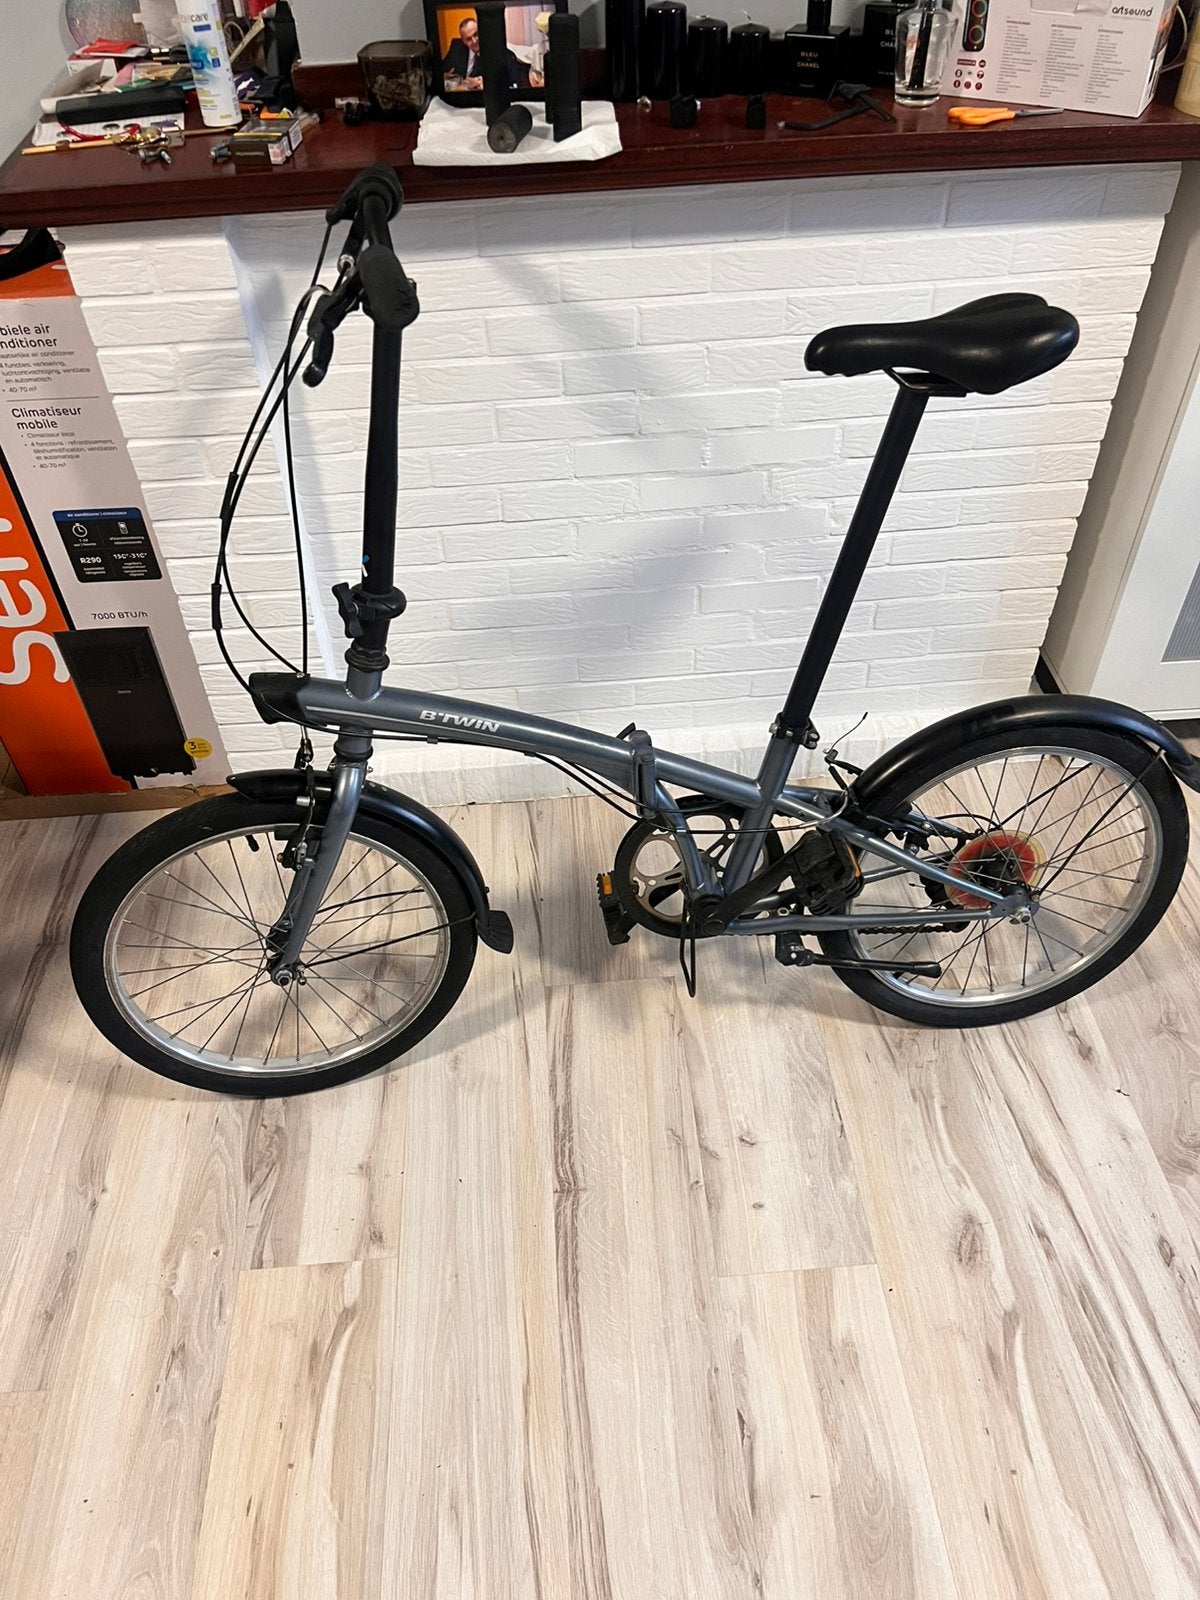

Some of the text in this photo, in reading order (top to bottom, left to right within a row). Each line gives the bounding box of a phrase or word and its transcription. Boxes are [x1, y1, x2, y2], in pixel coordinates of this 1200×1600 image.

[1111, 5, 1153, 18] artsound
[880, 40, 896, 48] CHA
[796, 61, 820, 69] CHANEL
[33, 323, 50, 334] air
[0, 337, 58, 349] nditioner
[11, 406, 82, 418] Climatiseur
[16, 418, 59, 430] mobile
[79, 556, 102, 564] R290
[91, 611, 149, 620] 7000 BTU/h
[187, 741, 197, 750] 3
